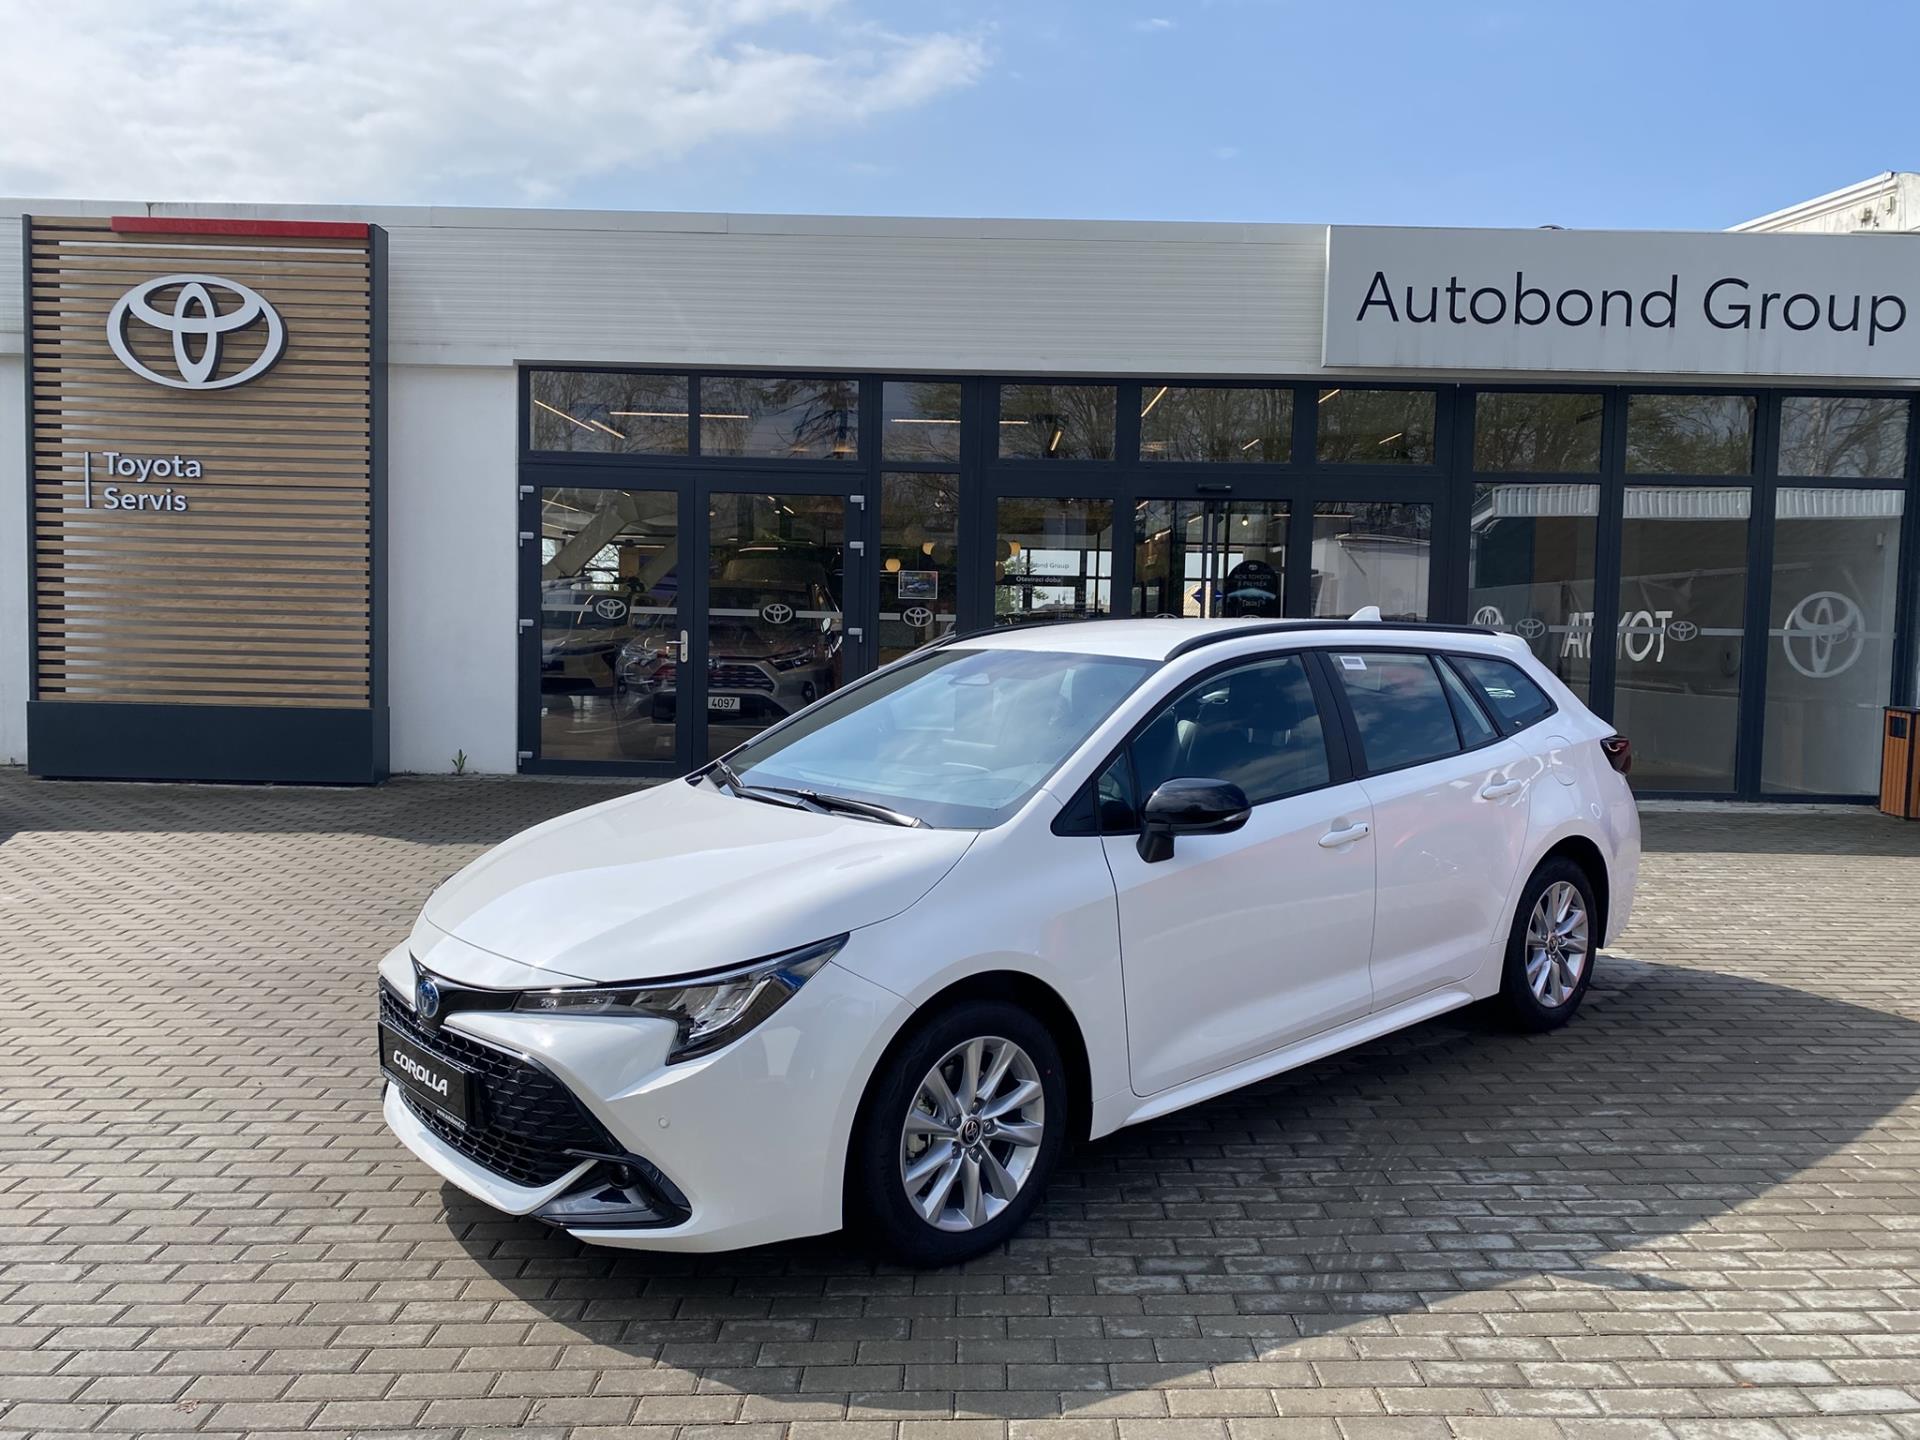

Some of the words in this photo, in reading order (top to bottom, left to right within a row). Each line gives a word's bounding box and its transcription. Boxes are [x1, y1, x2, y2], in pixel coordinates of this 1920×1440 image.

[1356, 271, 1678, 329] Autobond
[1703, 277, 1907, 347] Group
[102, 451, 202, 483] Toyota
[103, 487, 188, 511] Servis
[711, 698, 736, 709] 4097
[393, 1049, 448, 1097] COROLLA
